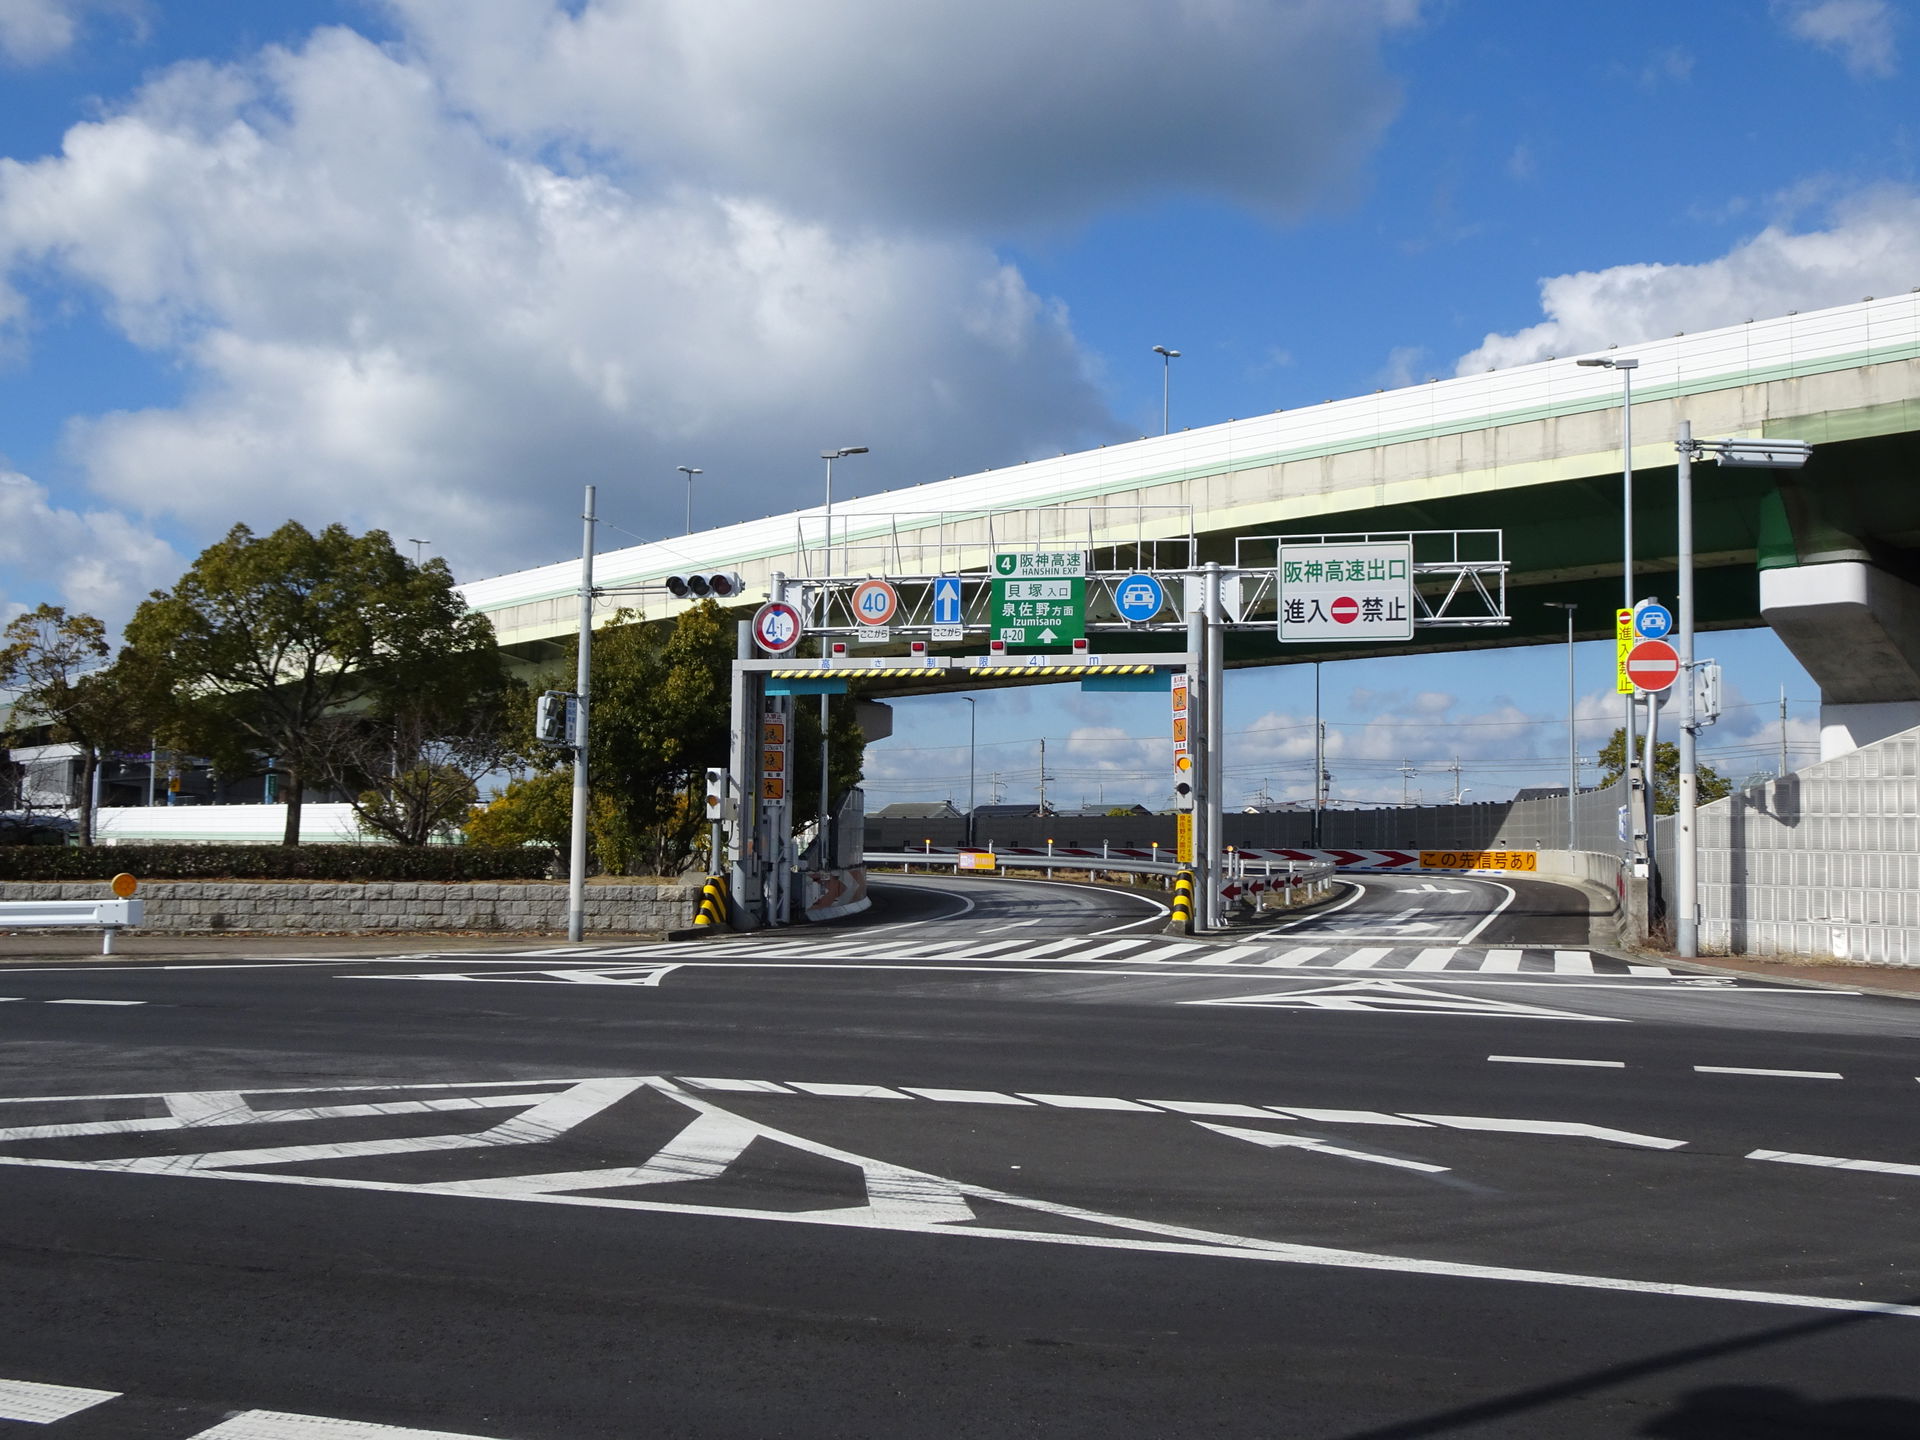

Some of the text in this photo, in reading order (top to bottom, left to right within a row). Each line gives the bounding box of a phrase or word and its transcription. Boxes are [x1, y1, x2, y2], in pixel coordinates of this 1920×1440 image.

[1001, 557, 1011, 570] 4
[1020, 553, 1081, 567] 阪神高速
[1284, 558, 1406, 583] 阪神高速出口
[863, 593, 886, 612] 40
[1002, 602, 1074, 616] 泉佐野方面
[1284, 597, 1407, 624] 進入 禁止
[1013, 617, 1061, 626] Izumisano
[860, 629, 887, 638] ここから
[933, 628, 961, 637] ここから
[1002, 630, 1023, 640] 4-20
[1423, 852, 1535, 869] この先信号あり
